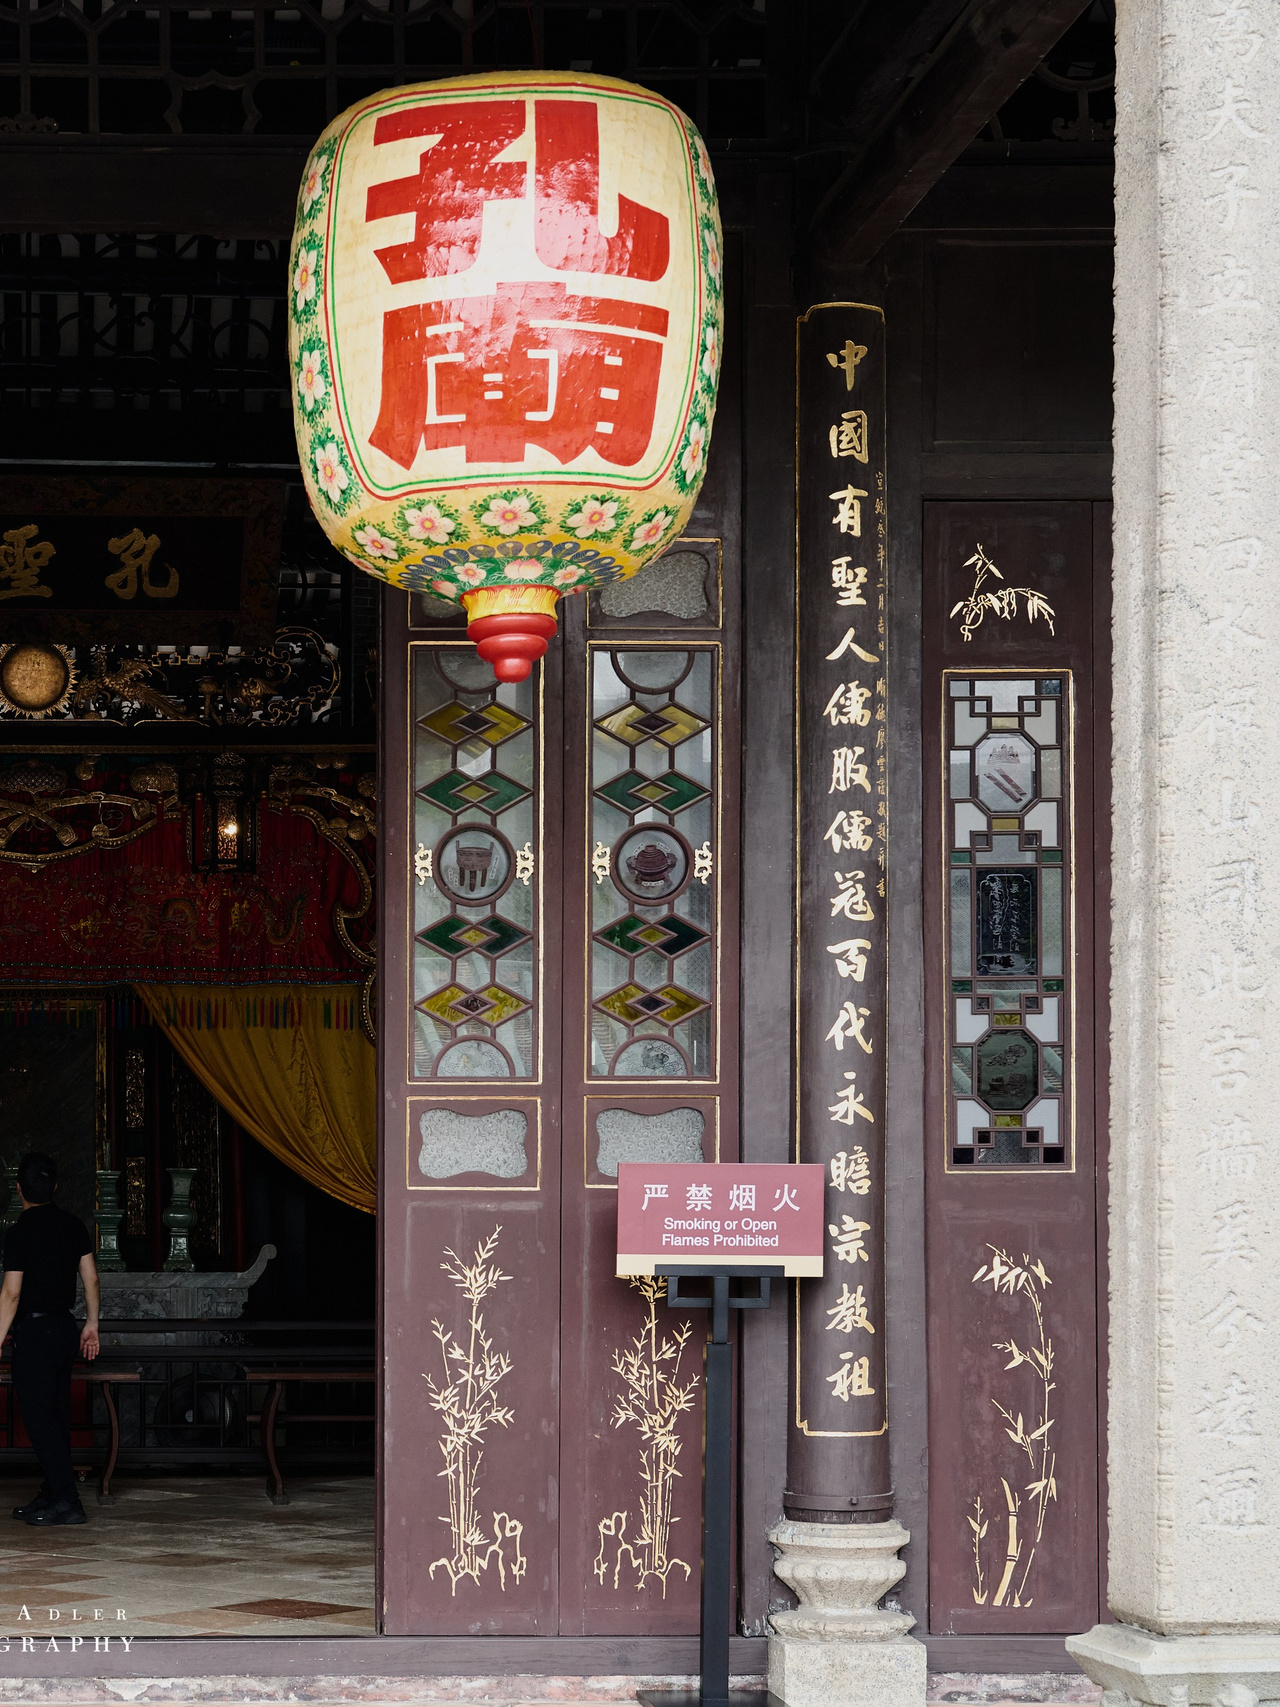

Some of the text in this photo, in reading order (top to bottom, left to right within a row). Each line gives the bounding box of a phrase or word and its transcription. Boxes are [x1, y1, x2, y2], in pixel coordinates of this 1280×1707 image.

[641, 1184, 801, 1212] 严禁烟火
[664, 1217, 777, 1233] Smoking or Open
[662, 1234, 779, 1247] Flames Prohibited
